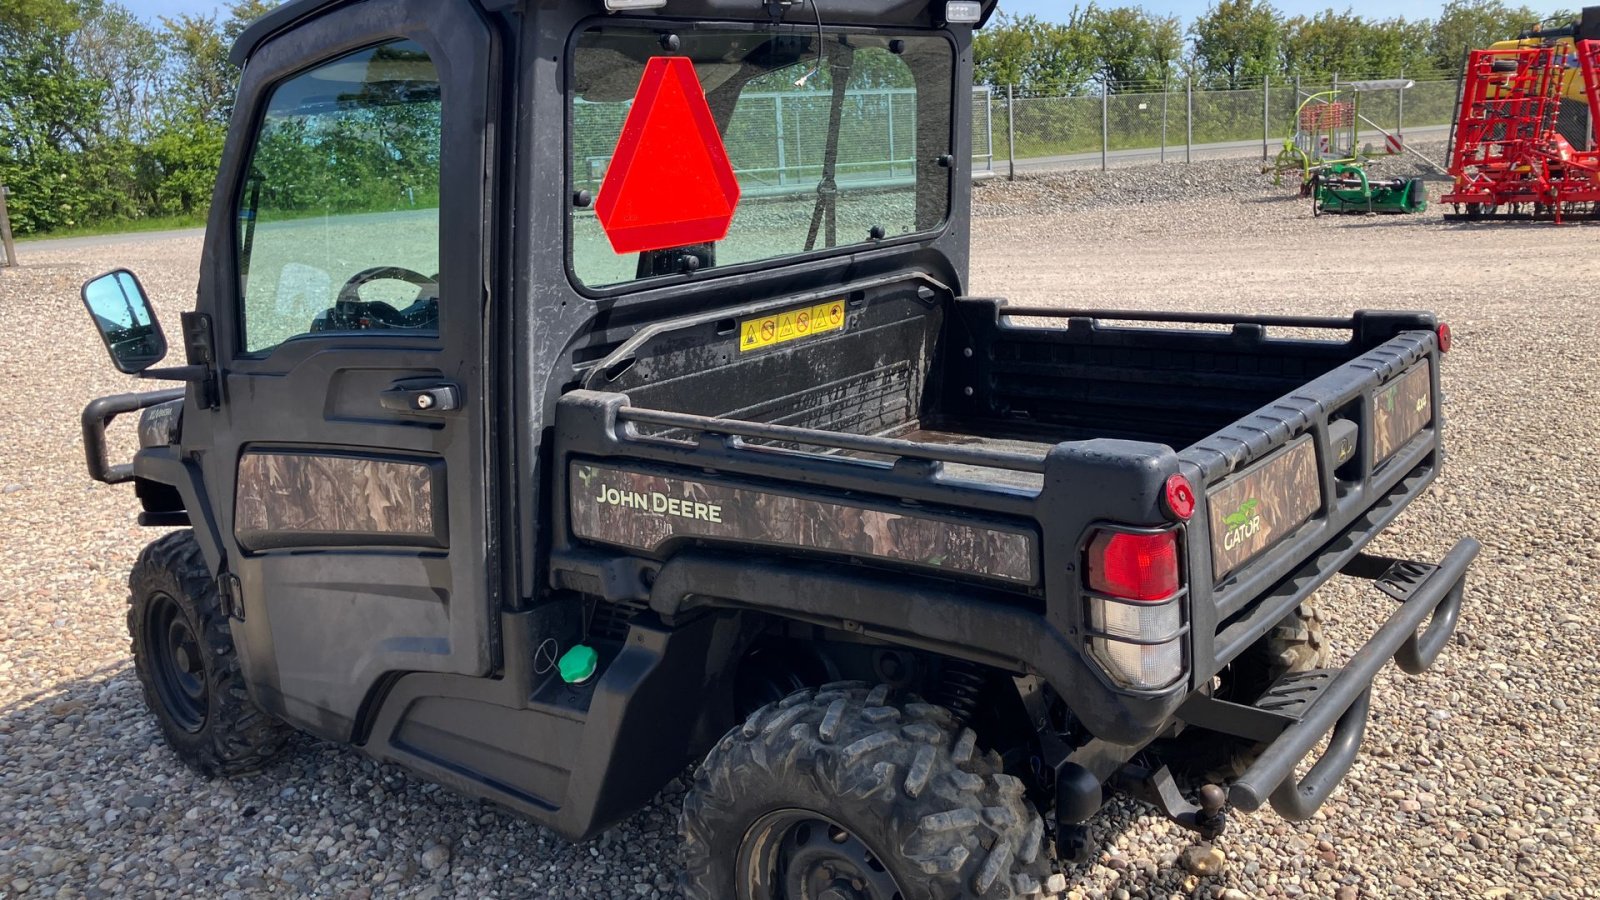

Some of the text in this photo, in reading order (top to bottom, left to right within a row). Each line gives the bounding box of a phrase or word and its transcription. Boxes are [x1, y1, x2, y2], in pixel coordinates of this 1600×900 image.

[596, 484, 722, 523] JOHN DEERE
[1224, 515, 1260, 551] GATOR
